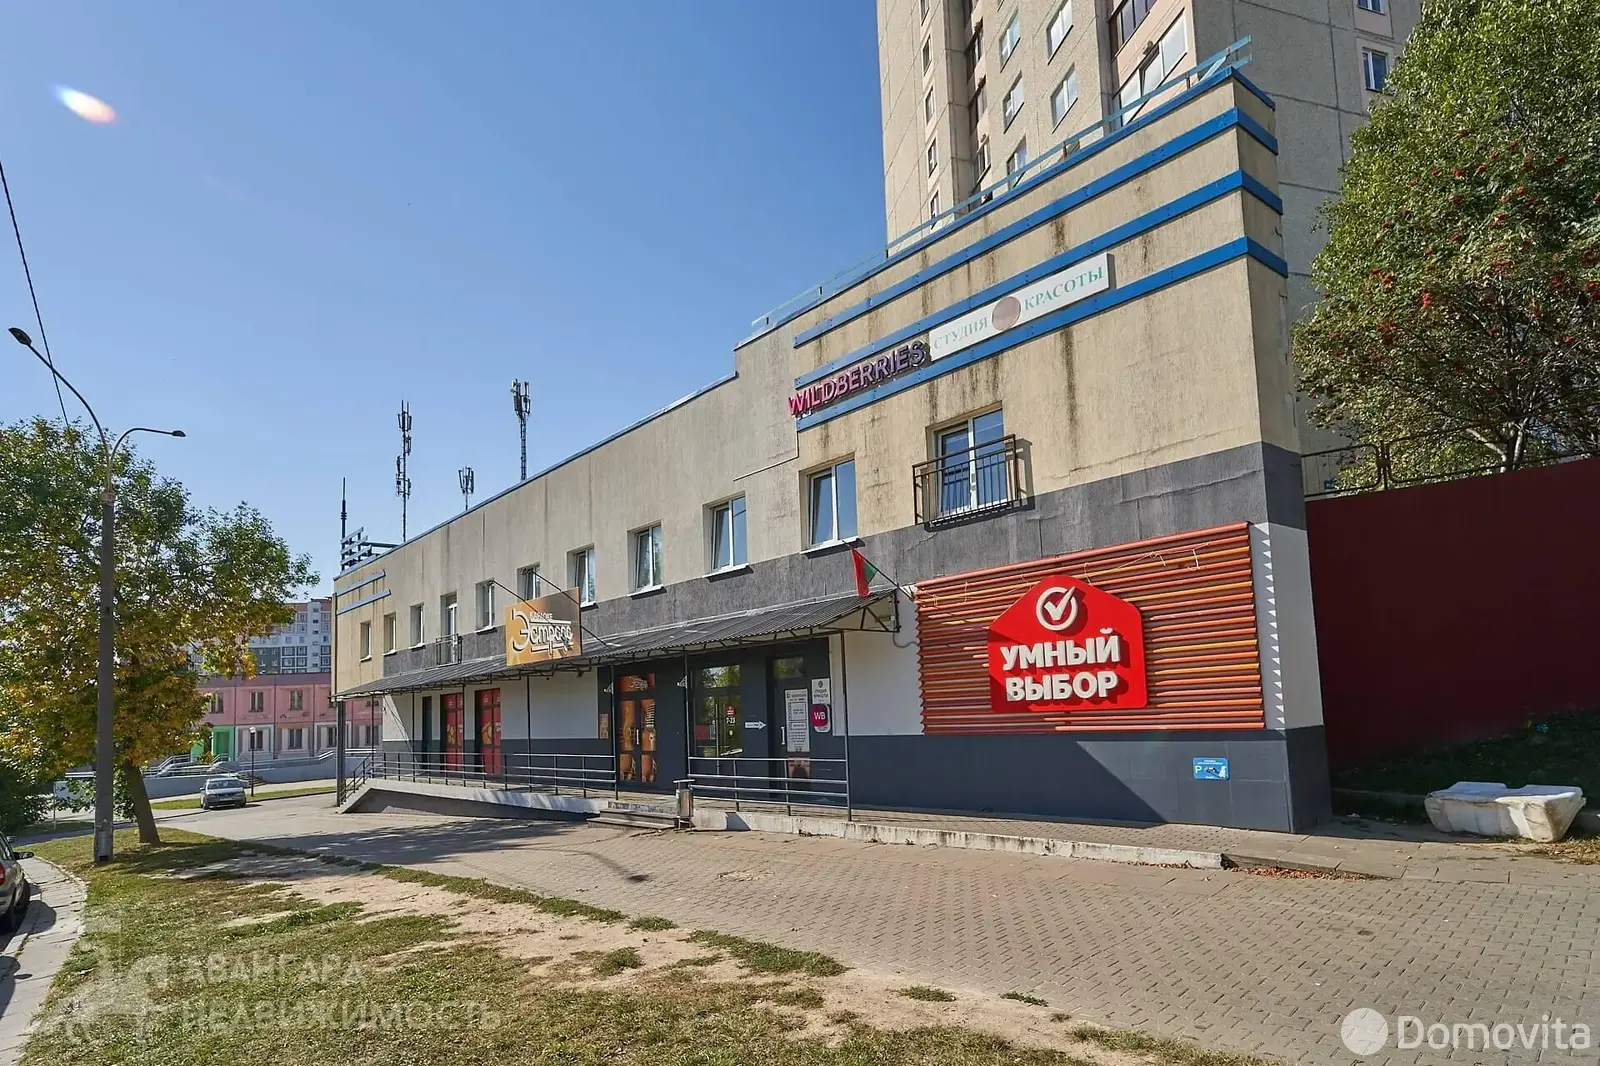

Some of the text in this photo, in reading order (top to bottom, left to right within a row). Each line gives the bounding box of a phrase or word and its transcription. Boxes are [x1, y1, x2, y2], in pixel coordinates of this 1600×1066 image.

[934, 266, 1104, 350] СТУДИЯ КРАСОТЫ
[787, 340, 928, 414] WILDBERRIES
[1000, 627, 1120, 670] УМНЫЙ
[1005, 671, 1118, 701] ВЫБОР
[814, 712, 826, 720] WB
